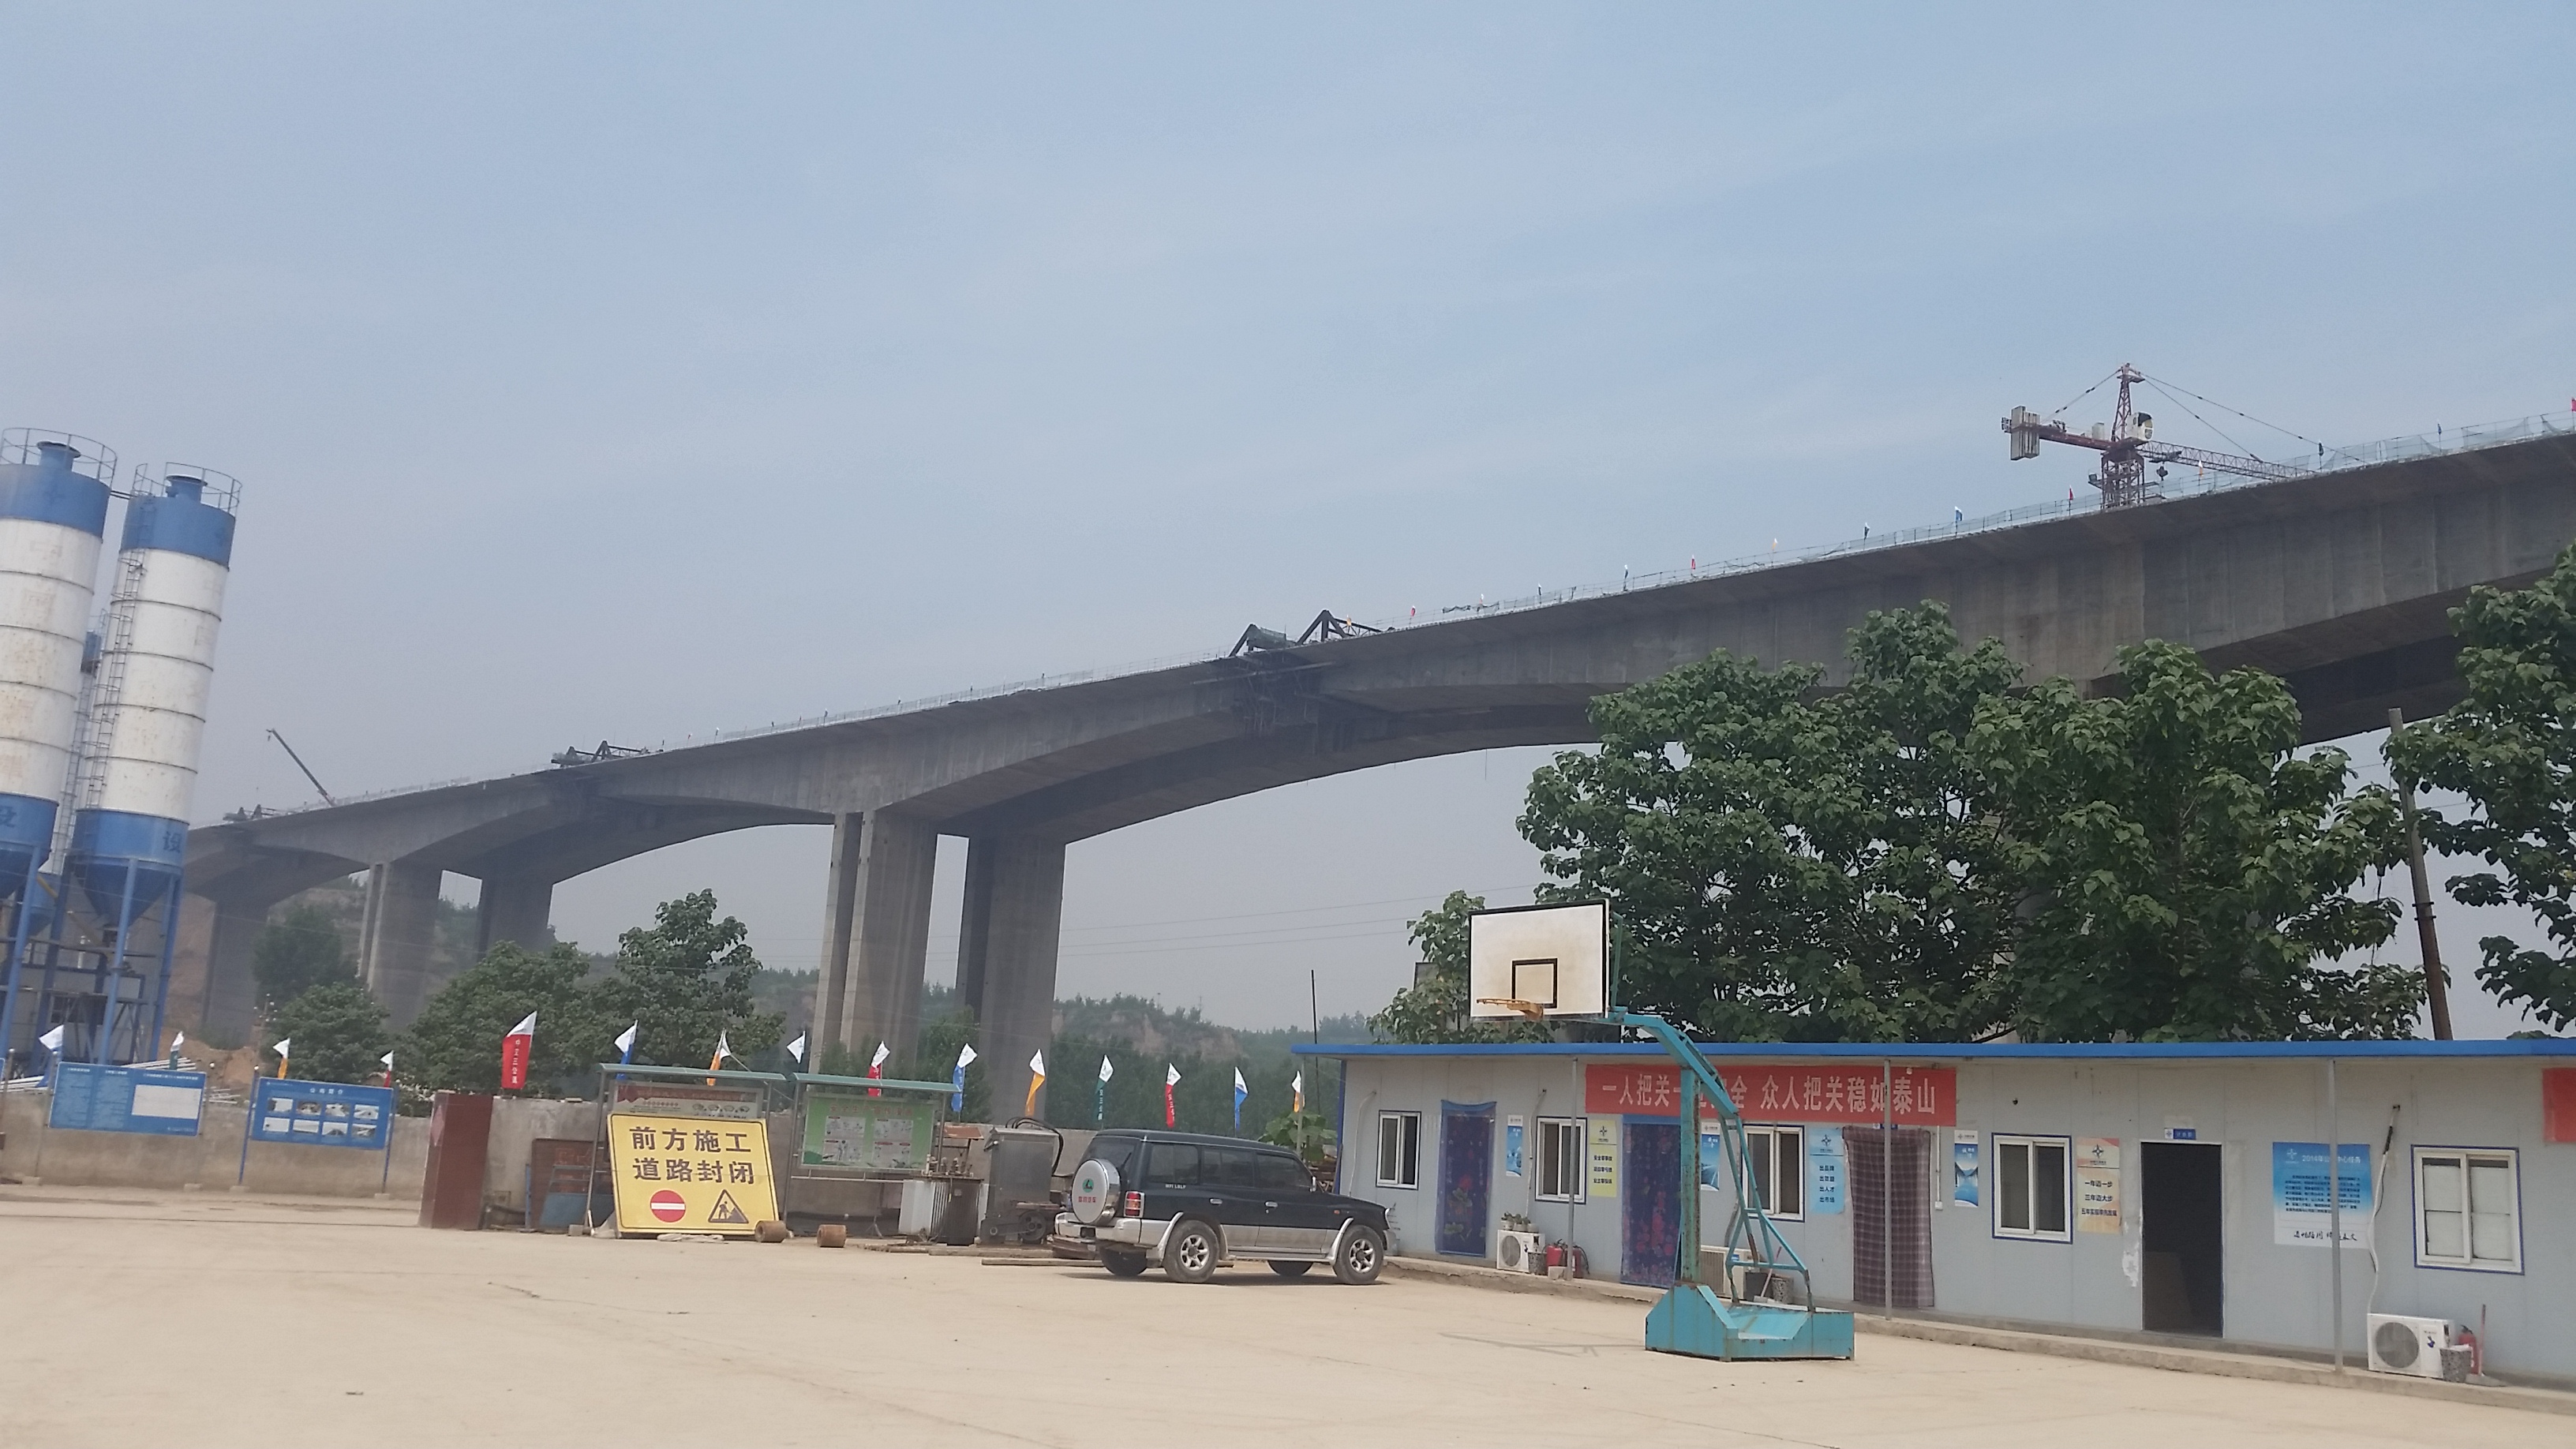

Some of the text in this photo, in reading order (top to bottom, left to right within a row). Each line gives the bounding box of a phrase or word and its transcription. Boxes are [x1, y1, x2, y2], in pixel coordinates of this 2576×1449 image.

[1760, 1074, 1936, 1114] 众人把关稳如泰山
[629, 1126, 751, 1153] 前方施工
[633, 1157, 754, 1185] 道路封闭
[2302, 1155, 2361, 1164] 2014年公中心任务
